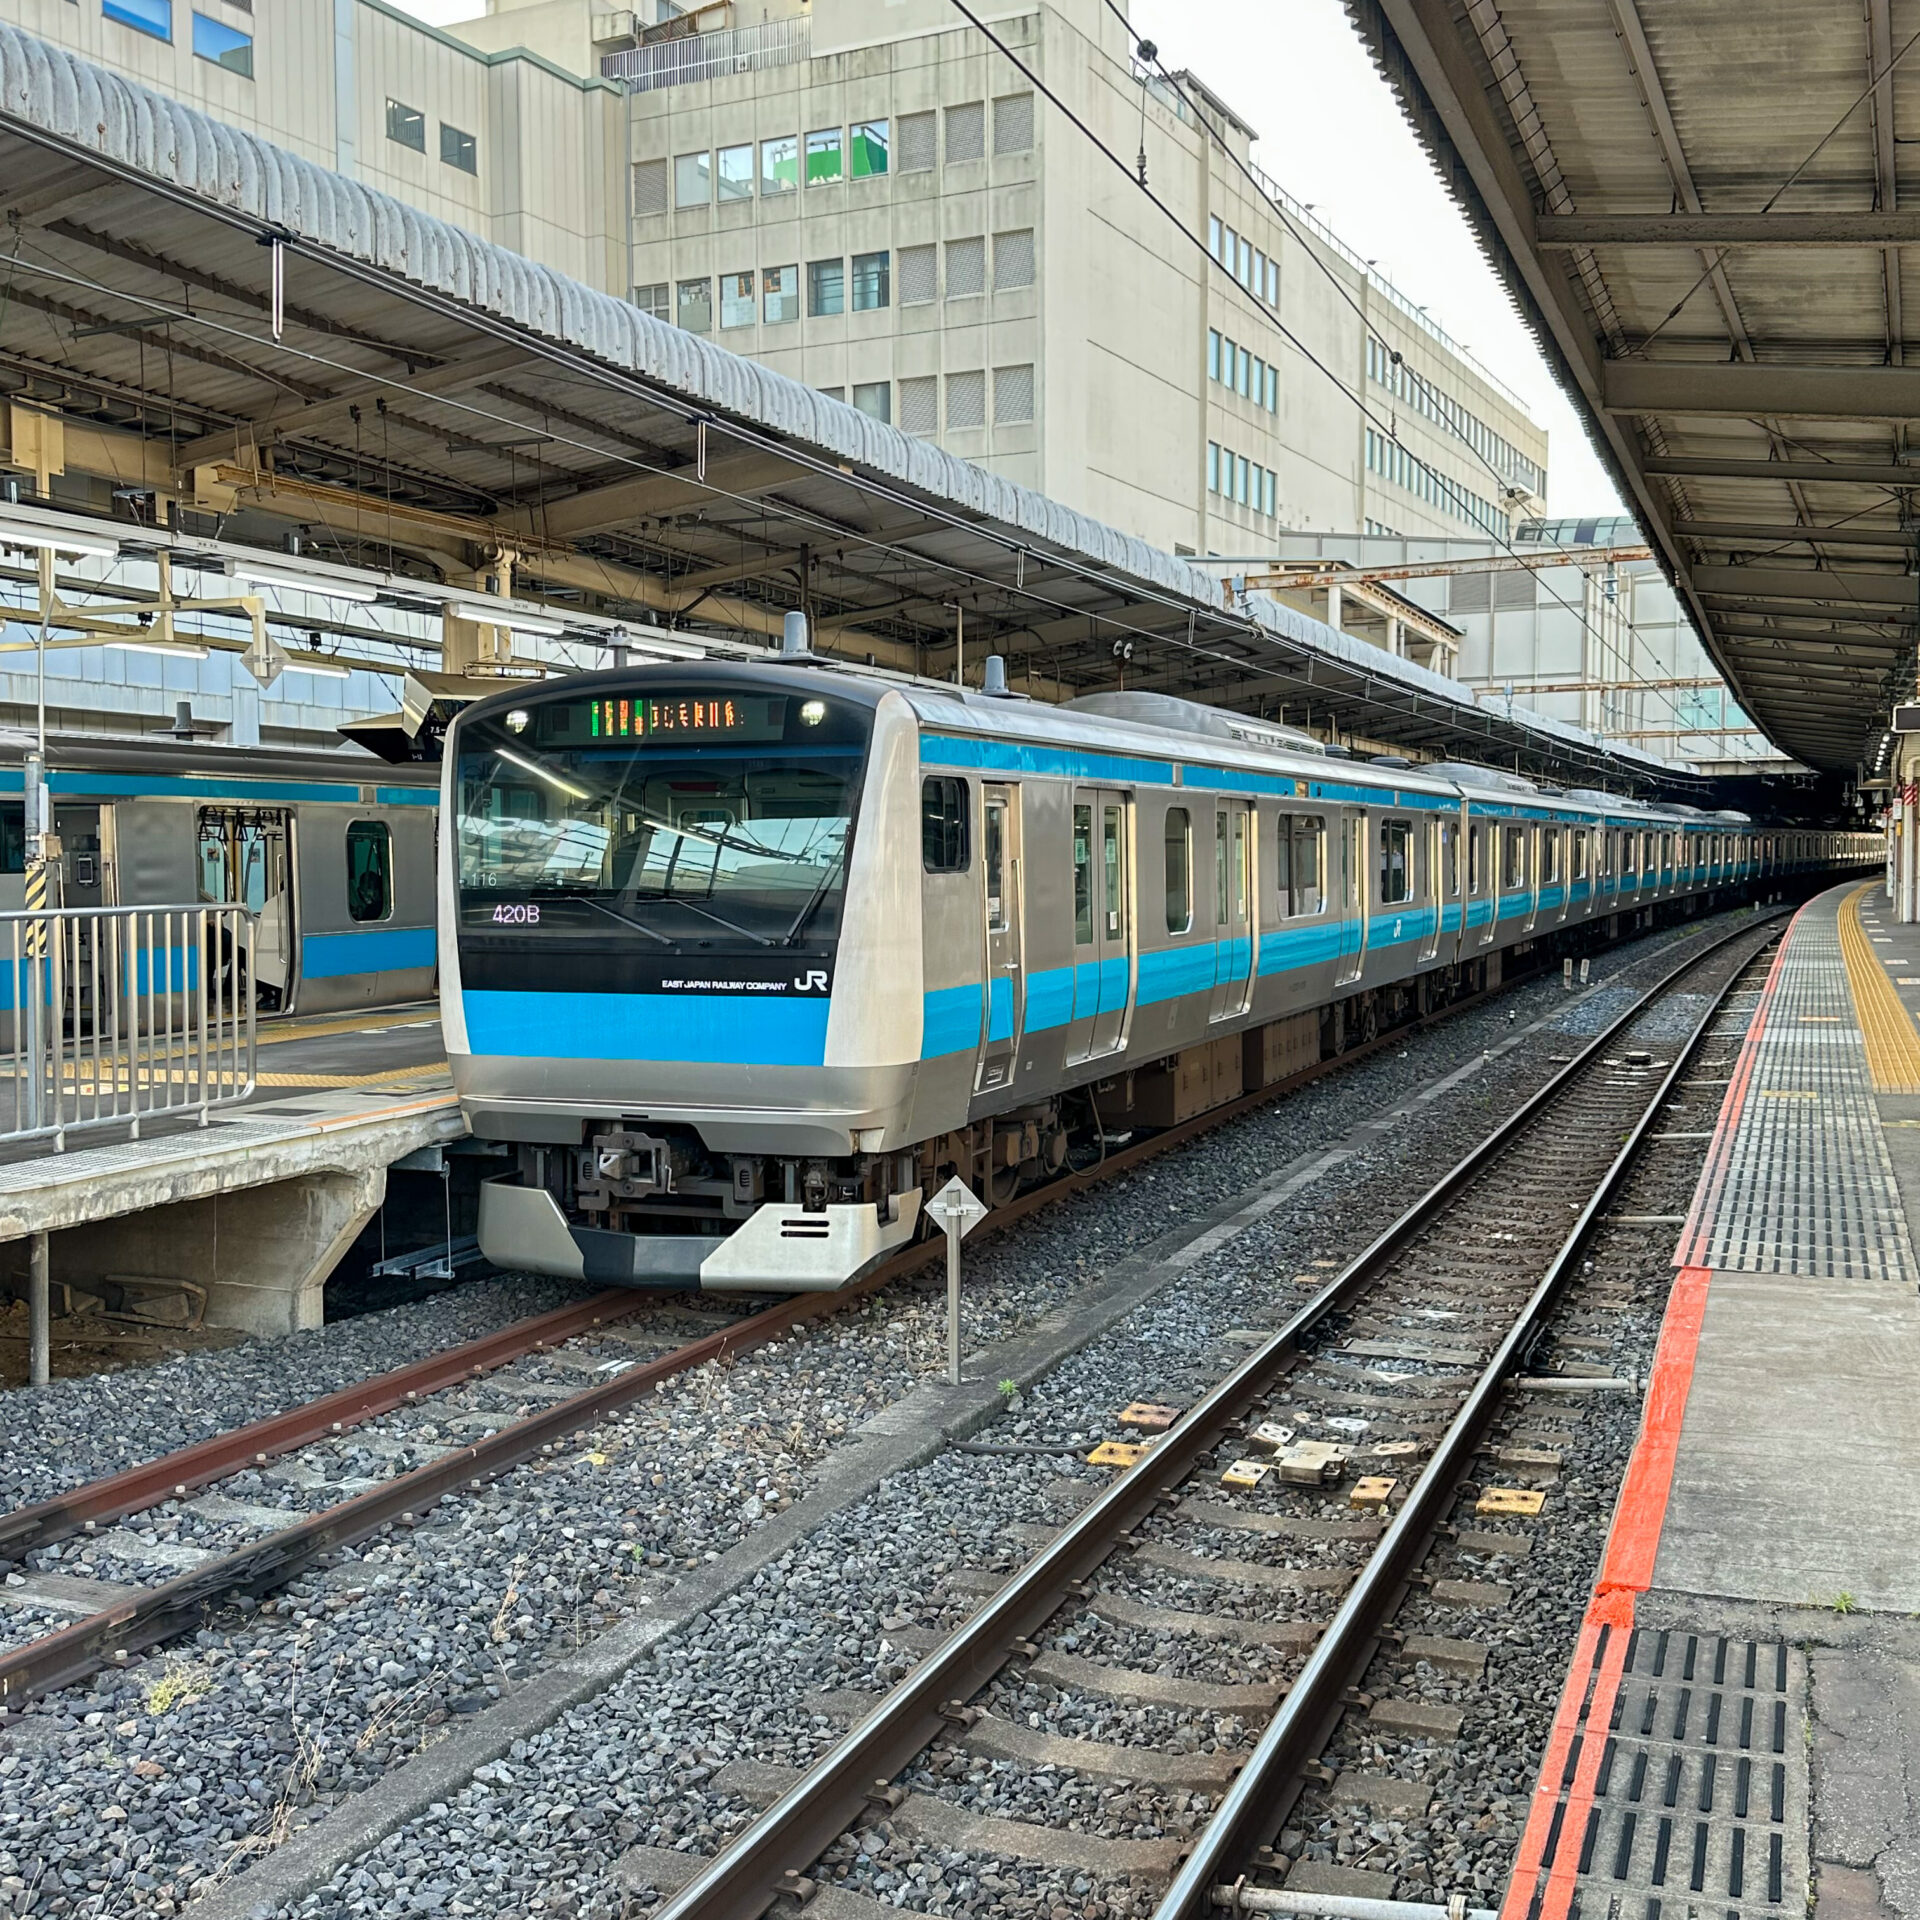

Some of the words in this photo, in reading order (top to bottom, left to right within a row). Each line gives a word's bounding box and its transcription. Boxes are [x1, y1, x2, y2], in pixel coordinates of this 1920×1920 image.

[471, 872, 497, 886] 116
[492, 904, 540, 923] 420B
[1393, 919, 1401, 937] JR
[661, 980, 683, 988] EAST
[683, 980, 711, 989] JAPAN
[712, 981, 745, 990] RAILWAY
[746, 982, 787, 991] COMPANY
[794, 970, 828, 991] JR
